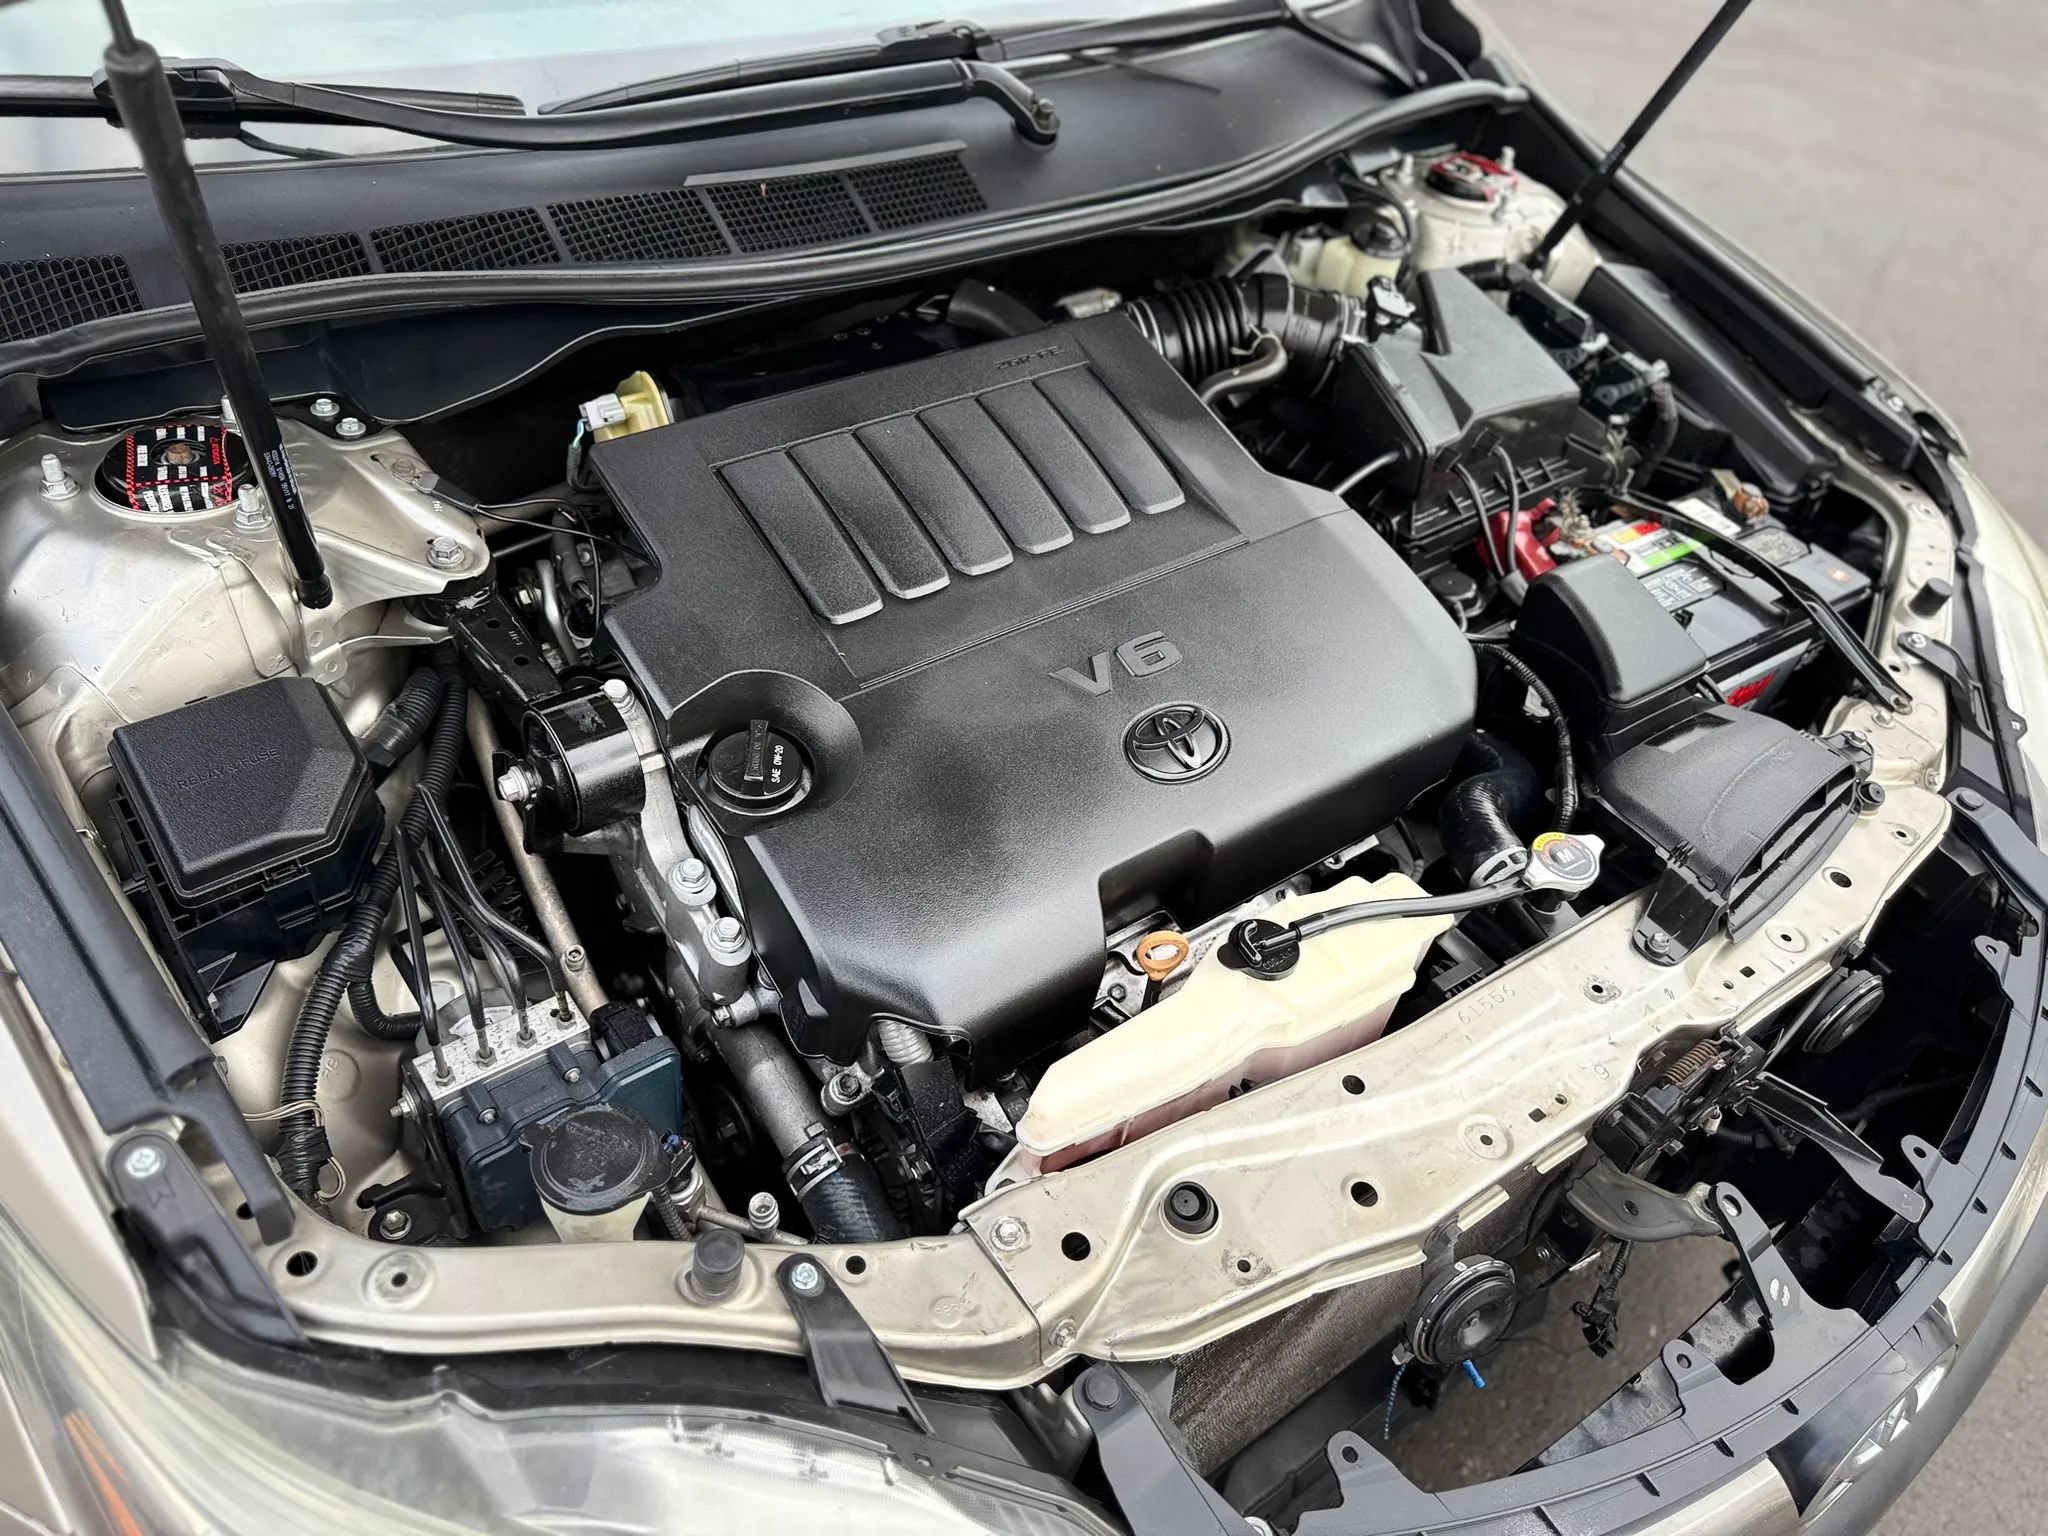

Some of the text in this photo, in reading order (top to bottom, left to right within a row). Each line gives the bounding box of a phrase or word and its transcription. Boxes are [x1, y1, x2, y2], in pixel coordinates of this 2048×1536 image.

[1047, 629, 1183, 698] V6
[176, 767, 225, 790] RELAY
[239, 748, 281, 769] FUSE
[771, 744, 785, 784] SAE 0W-20
